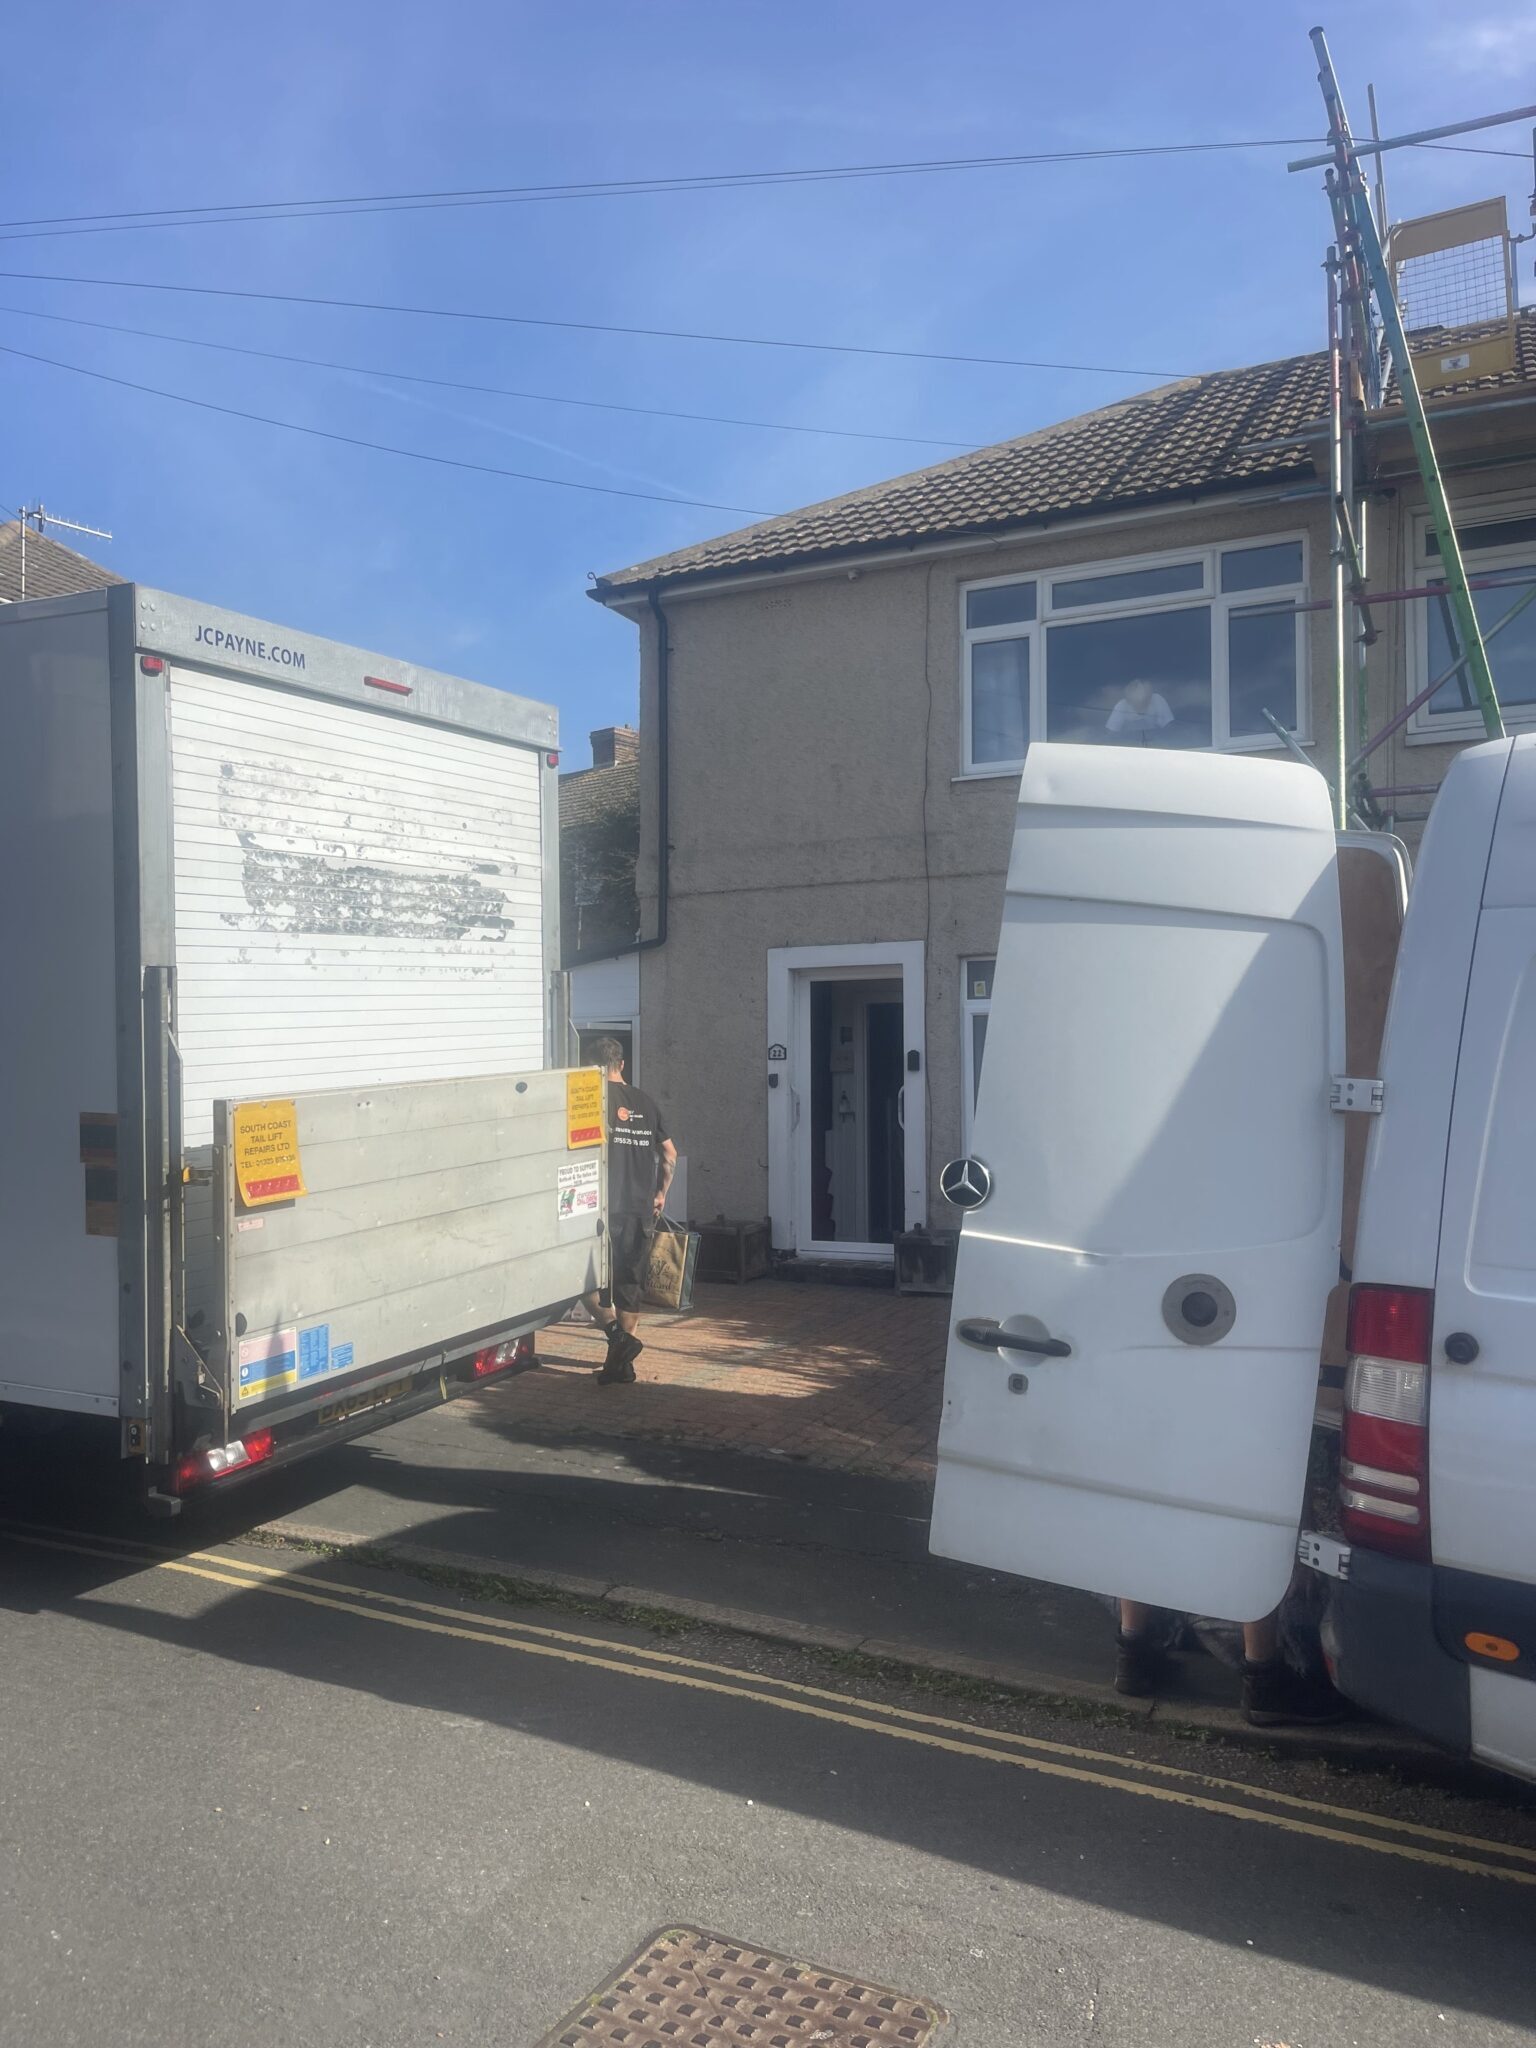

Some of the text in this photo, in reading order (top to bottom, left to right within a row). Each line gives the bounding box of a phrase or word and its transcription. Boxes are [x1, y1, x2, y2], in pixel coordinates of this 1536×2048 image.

[195, 625, 306, 669] JCPAYNE.COM
[240, 1120, 291, 1134] SOUTH COAST
[250, 1132, 283, 1144] TAIL LIFT
[244, 1143, 290, 1156] REPAIRS LTD
[559, 1167, 573, 1176] PROUD
